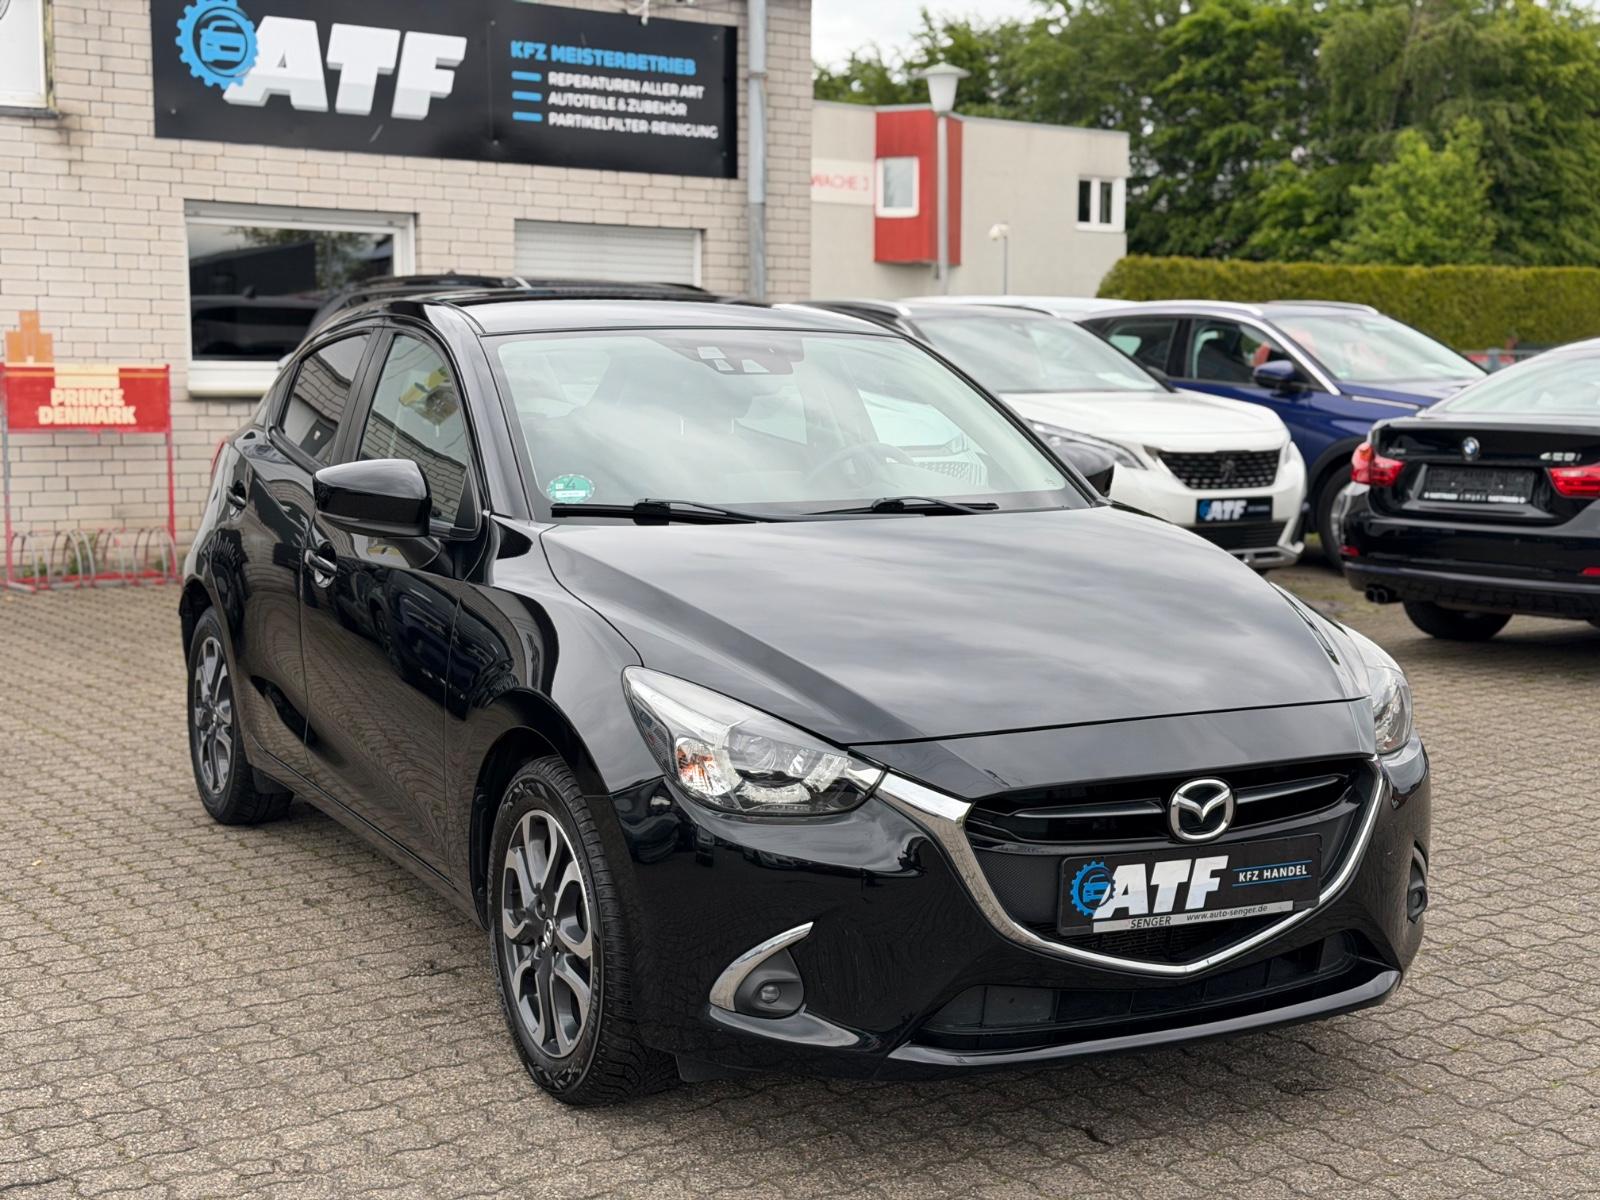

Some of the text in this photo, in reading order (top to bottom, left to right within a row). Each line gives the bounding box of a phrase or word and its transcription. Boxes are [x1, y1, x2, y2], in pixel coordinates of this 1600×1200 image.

[222, 15, 467, 120] ATF
[510, 40, 696, 76] KFZ MEISTERBETRIEB
[547, 71, 705, 99] REPERATUREN ALLER ART
[548, 92, 687, 116] AUTOTEILE & ZUBEHÖR
[50, 388, 125, 407] PRINCE
[38, 405, 137, 425] DENMARK
[1205, 500, 1247, 521] ATF
[1238, 865, 1307, 883] KFZ HANDEL
[1093, 855, 1229, 919] ATF
[1130, 904, 1268, 929] SENGER www.auto-senger.de
